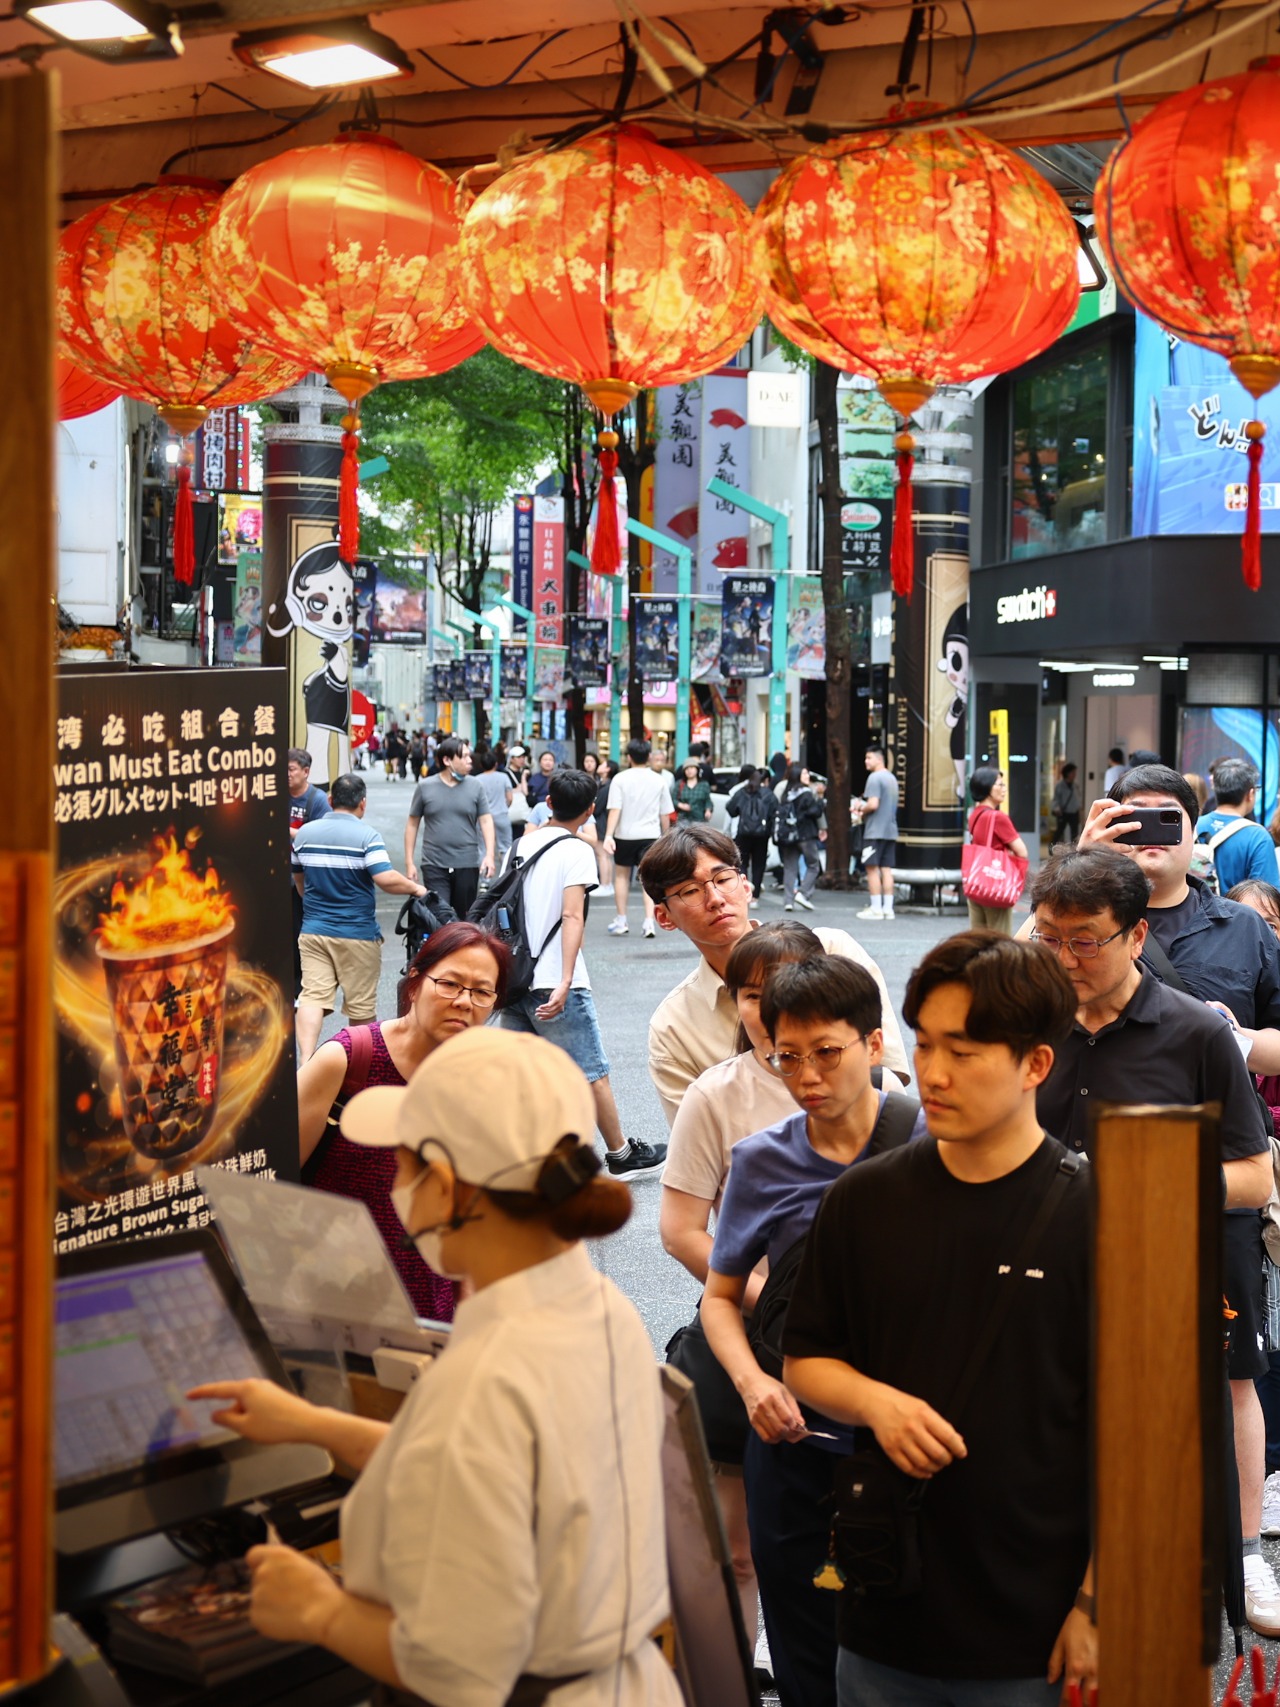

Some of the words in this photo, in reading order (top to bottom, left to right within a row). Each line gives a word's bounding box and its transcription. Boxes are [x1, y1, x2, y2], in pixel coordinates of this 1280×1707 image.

[997, 586, 1048, 624] swatch
[53, 761, 102, 787] wan
[109, 752, 163, 782] Must
[168, 748, 203, 776] Eat
[207, 742, 276, 772] Combo
[220, 775, 247, 804] 인기
[251, 773, 277, 801] 세트
[53, 1222, 118, 1255] ignature
[122, 1206, 168, 1233] Brown
